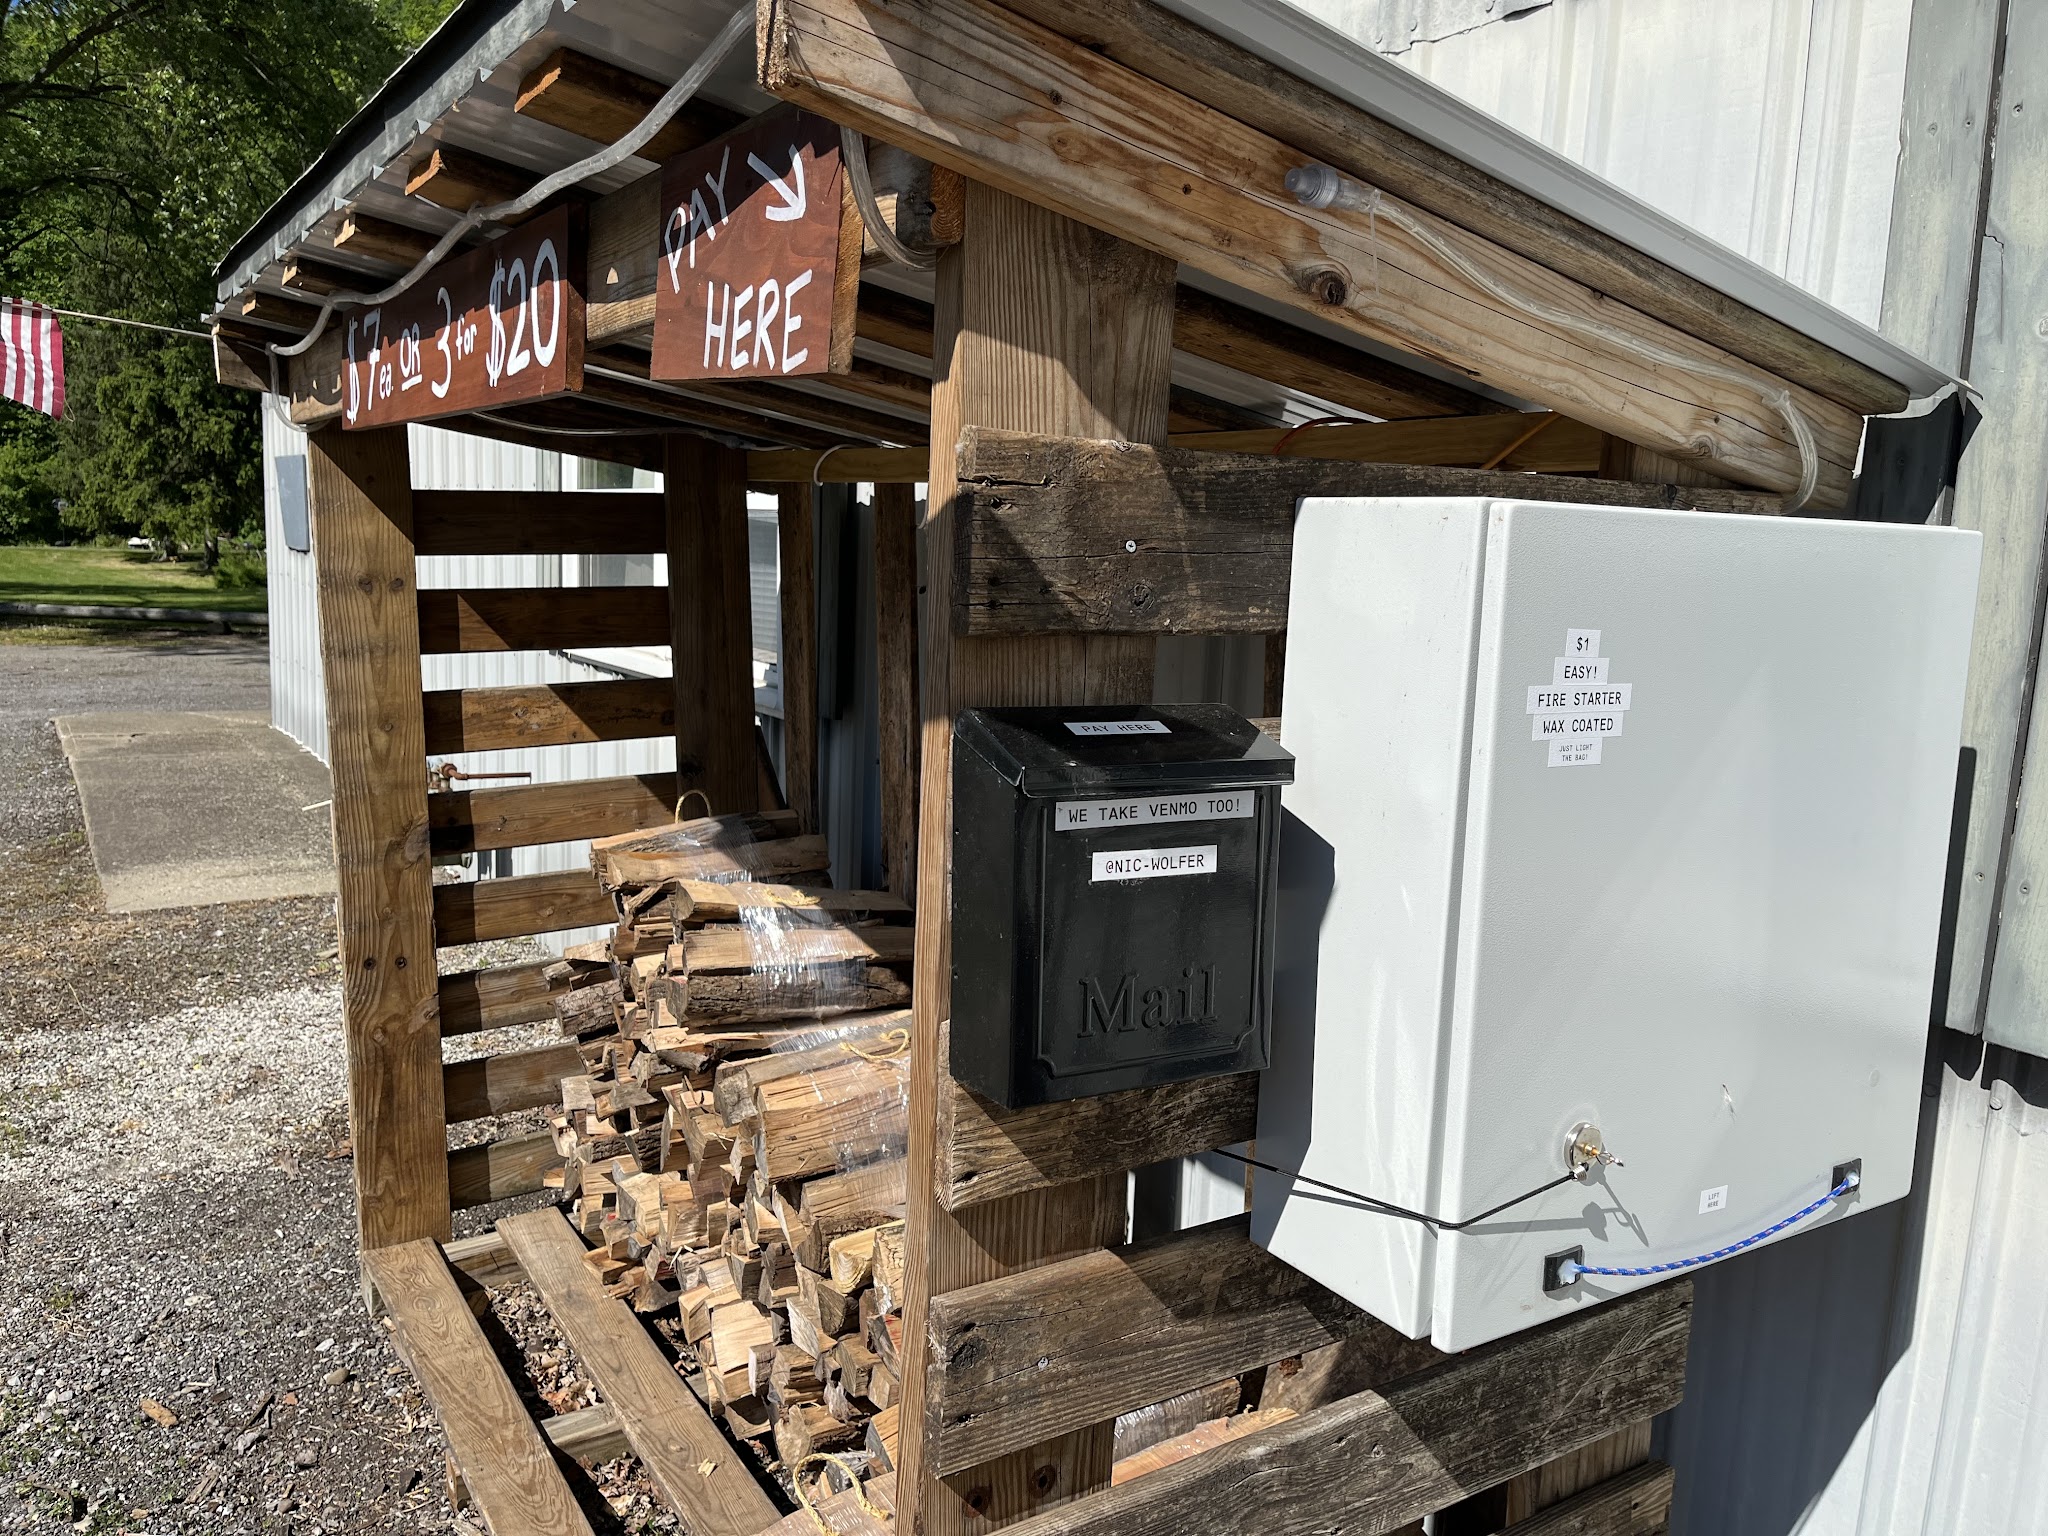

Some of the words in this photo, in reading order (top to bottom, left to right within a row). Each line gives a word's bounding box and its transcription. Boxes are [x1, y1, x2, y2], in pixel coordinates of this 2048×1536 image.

[664, 145, 730, 294] PAY
[400, 322, 421, 378] OR
[431, 286, 452, 399] 3
[455, 313, 477, 361] for
[485, 237, 560, 388] $20
[703, 269, 812, 373] HERE
[1576, 636, 1589, 652] $1
[1564, 665, 1598, 679] EASY!
[1538, 692, 1567, 707] FIRE
[1573, 691, 1622, 706] STARTER
[1081, 725, 1109, 733] PAY
[1116, 724, 1156, 732] HERE
[1543, 719, 1565, 734] WAX
[1572, 718, 1614, 732] COATED
[1559, 744, 1573, 753] JUST
[1575, 743, 1593, 752] LIGHT
[1561, 754, 1573, 762] THE
[1068, 808, 1088, 823] WE
[1099, 805, 1139, 821] TAKE
[1149, 801, 1198, 817] VENMO
[1207, 798, 1241, 814] TOO!
[1105, 853, 1205, 874] @NIC-WOLFER
[1077, 962, 1217, 1038] Mail
